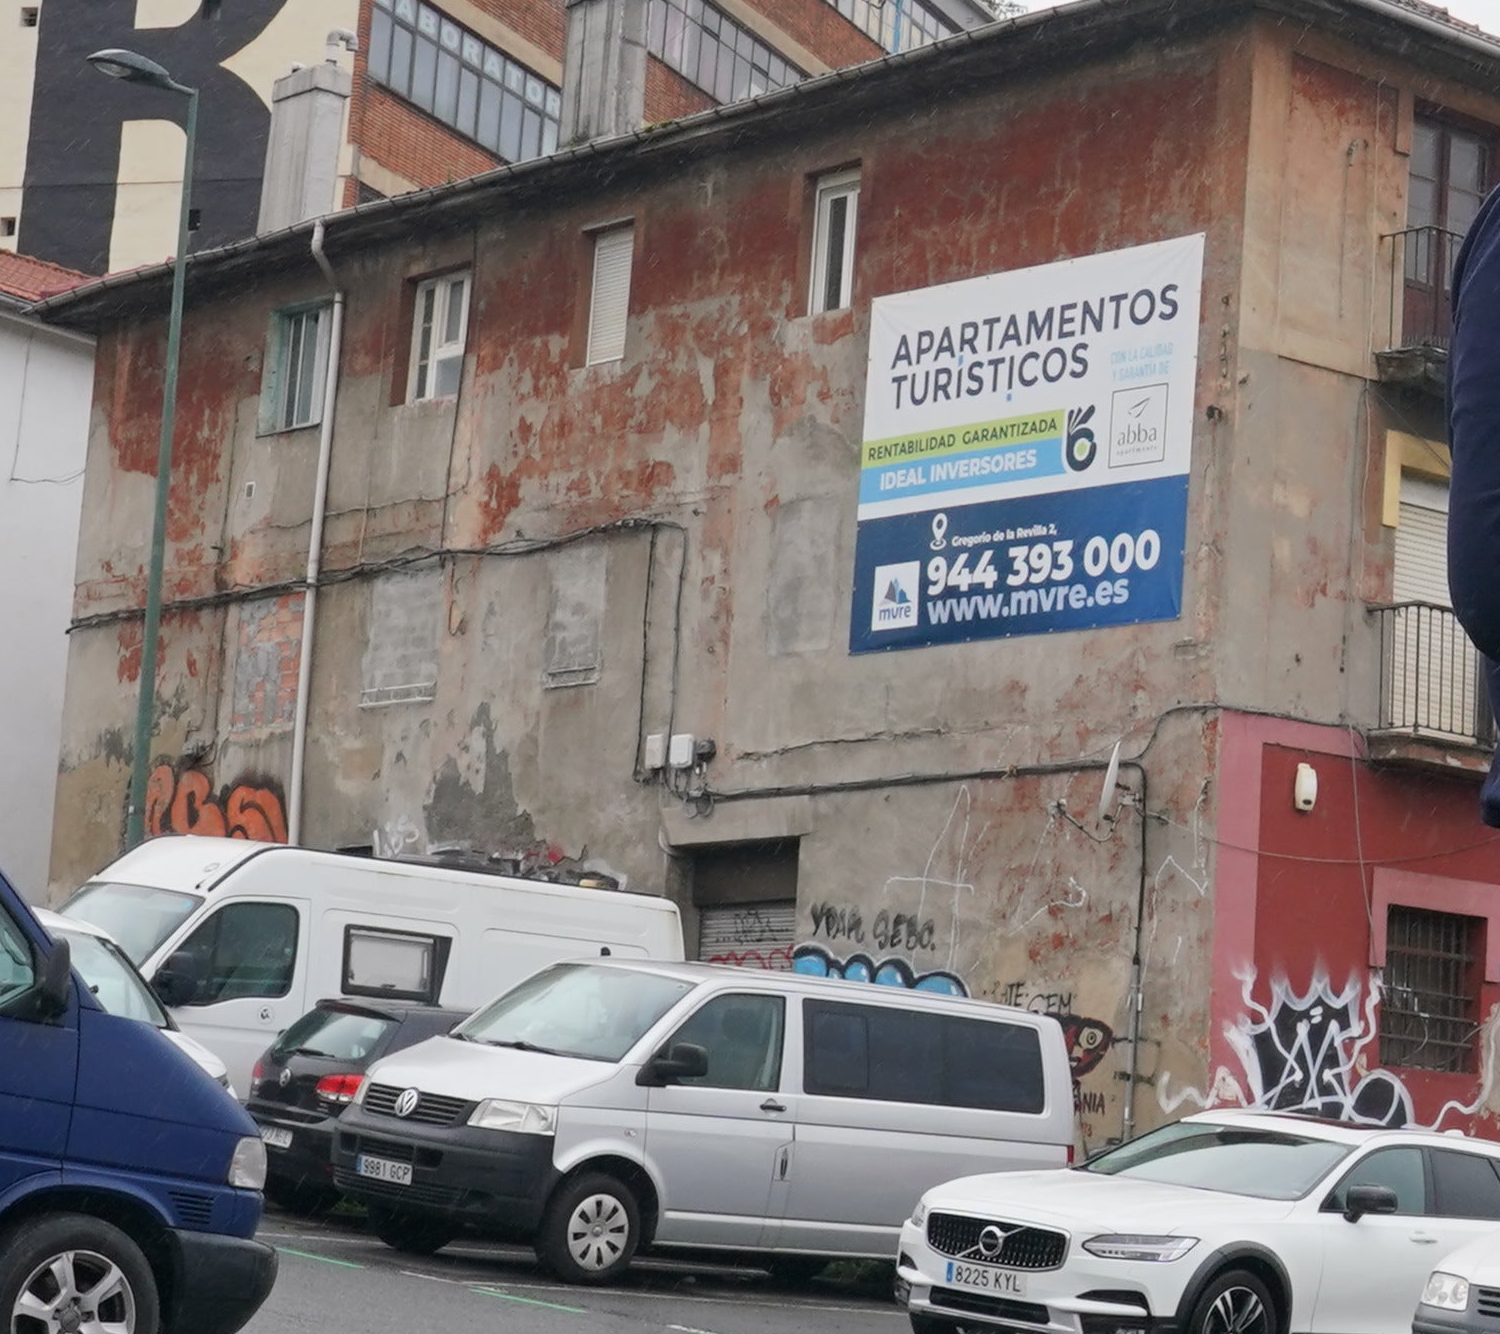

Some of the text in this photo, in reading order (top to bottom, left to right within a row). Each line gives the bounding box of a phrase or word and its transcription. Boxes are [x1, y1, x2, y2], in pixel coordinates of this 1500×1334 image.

[891, 284, 1179, 369] APARTAMENTOS
[868, 417, 1058, 461] RENTABILIDAD GARANTIZADA
[1117, 423, 1157, 446] abba
[880, 449, 1037, 491] IDEAL INVERSORES
[926, 529, 1161, 596] 944 393 000
[927, 578, 1130, 625] www.mvre.es
[955, 1266, 1022, 1292] 8225 KYL
